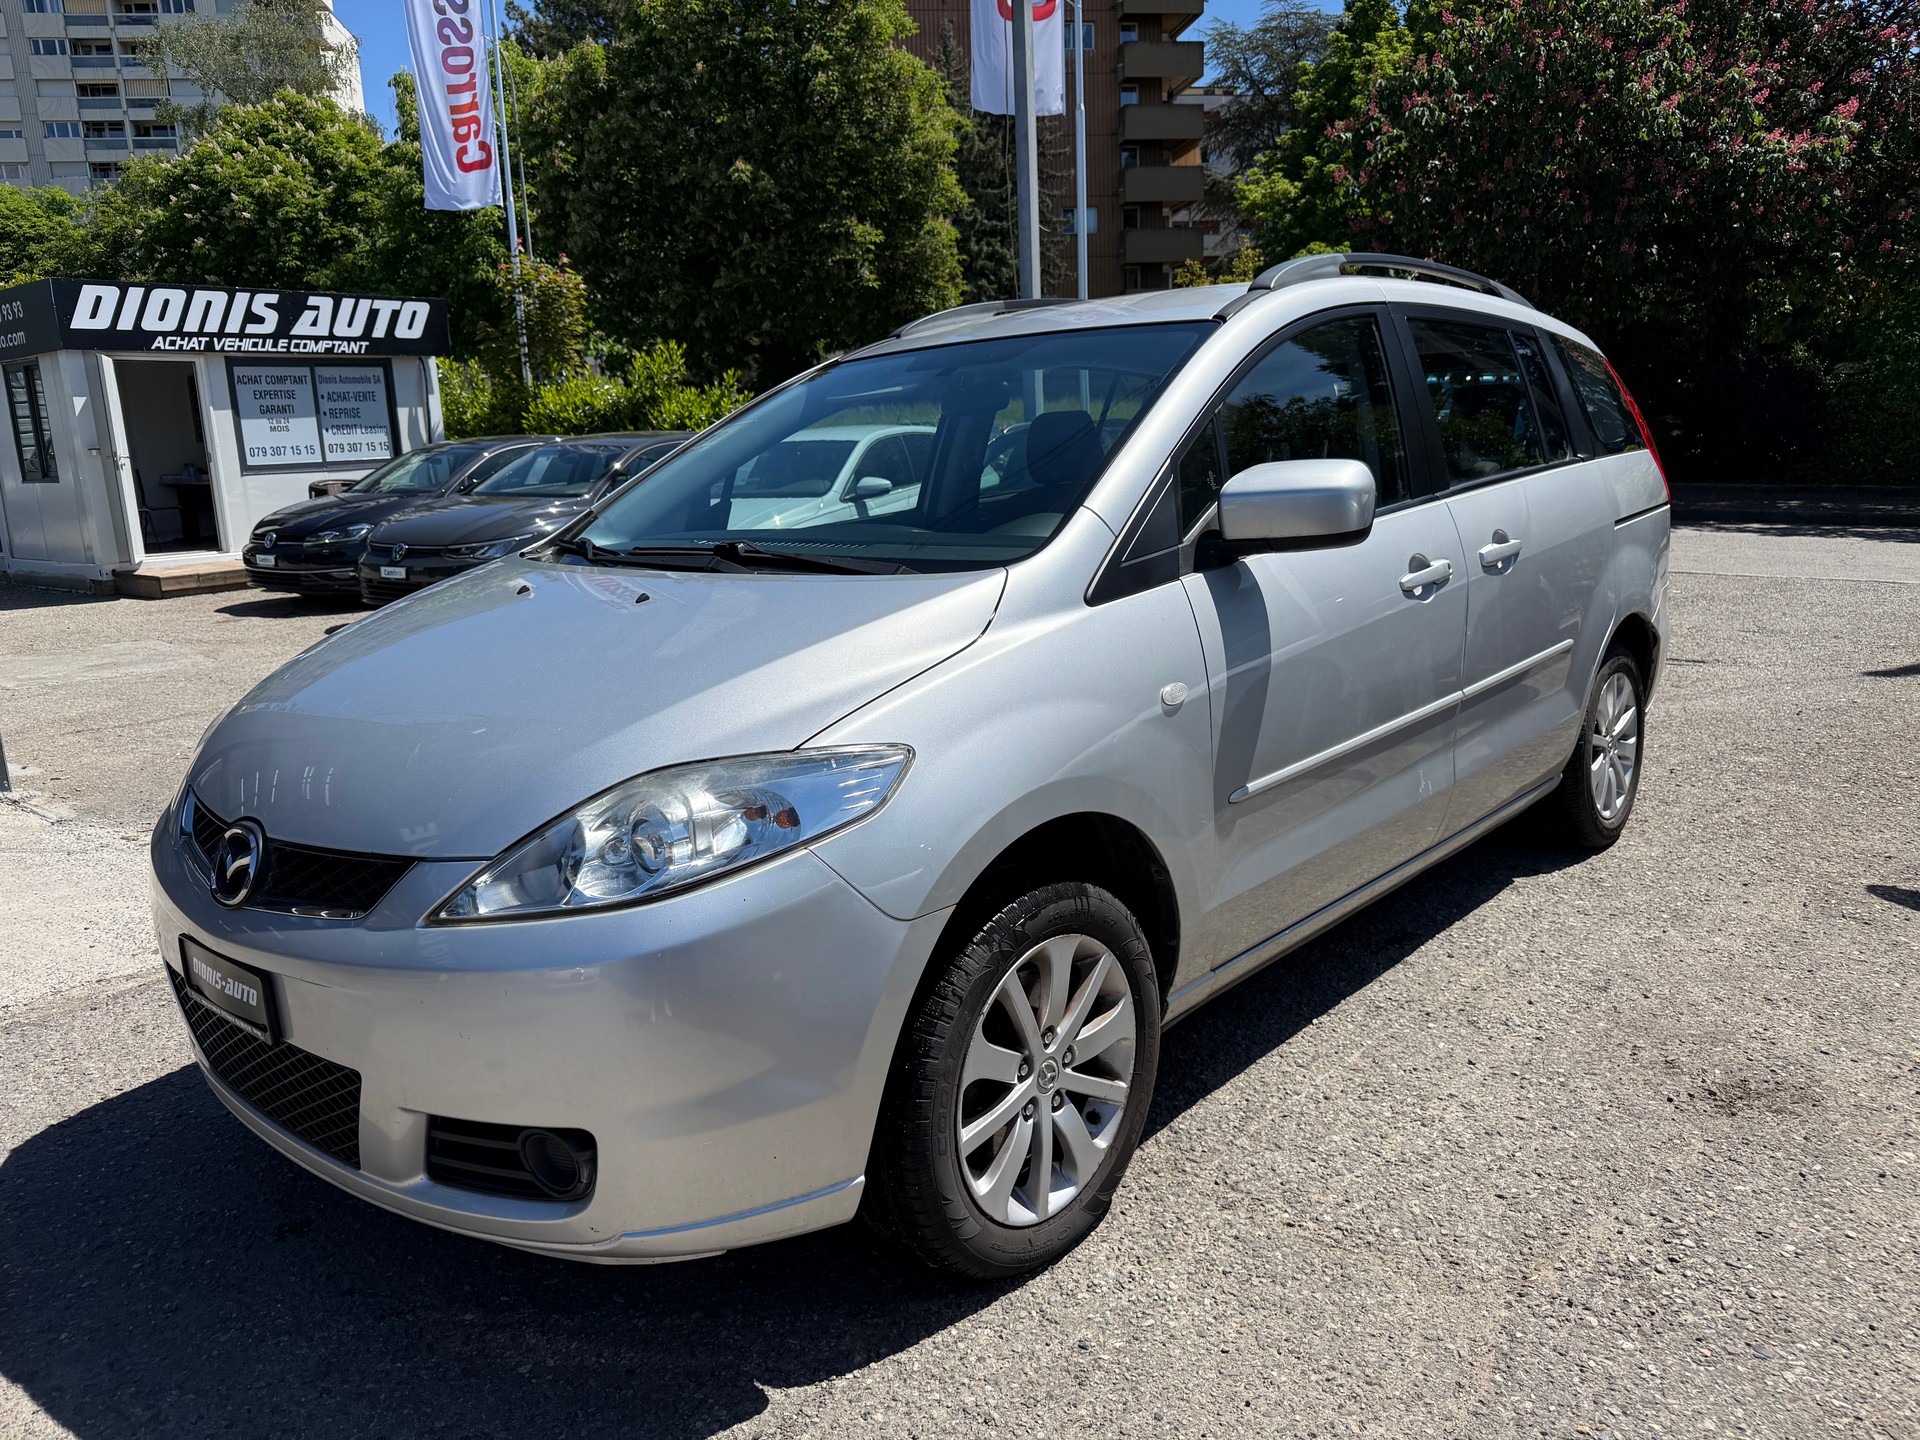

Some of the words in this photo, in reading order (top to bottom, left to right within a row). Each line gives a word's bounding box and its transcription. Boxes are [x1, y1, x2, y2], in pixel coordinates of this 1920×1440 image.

[1, 304, 13, 321] 93
[12, 300, 24, 318] 93
[70, 284, 280, 334] DIONIS
[290, 295, 430, 339] AUTO
[0, 331, 26, 348] o.com
[151, 336, 209, 351] ACHAT
[213, 337, 289, 352] VEHICULE
[290, 338, 370, 354] COMPTANT
[236, 375, 263, 386] ACHAT
[265, 374, 308, 385] COMPTANT
[318, 374, 338, 384] Dionis
[338, 374, 372, 384] Automobile
[372, 375, 382, 384] SA
[253, 389, 297, 400] EXPERTISE
[326, 391, 377, 403] ACHAT-VENTE
[259, 404, 295, 415] GARANTI
[328, 407, 361, 419] REPRISE
[269, 425, 290, 433] MOIS
[331, 424, 358, 436] CREDIT
[360, 424, 388, 437] Leasing
[249, 446, 268, 458] 079
[269, 445, 287, 457] 307
[289, 445, 302, 456] 15
[304, 444, 316, 455] 15
[328, 443, 345, 454] 079
[347, 442, 363, 453] 307
[365, 442, 377, 452] 15
[378, 441, 390, 451] 15
[192, 957, 258, 1007] DIONIS-AUTO
